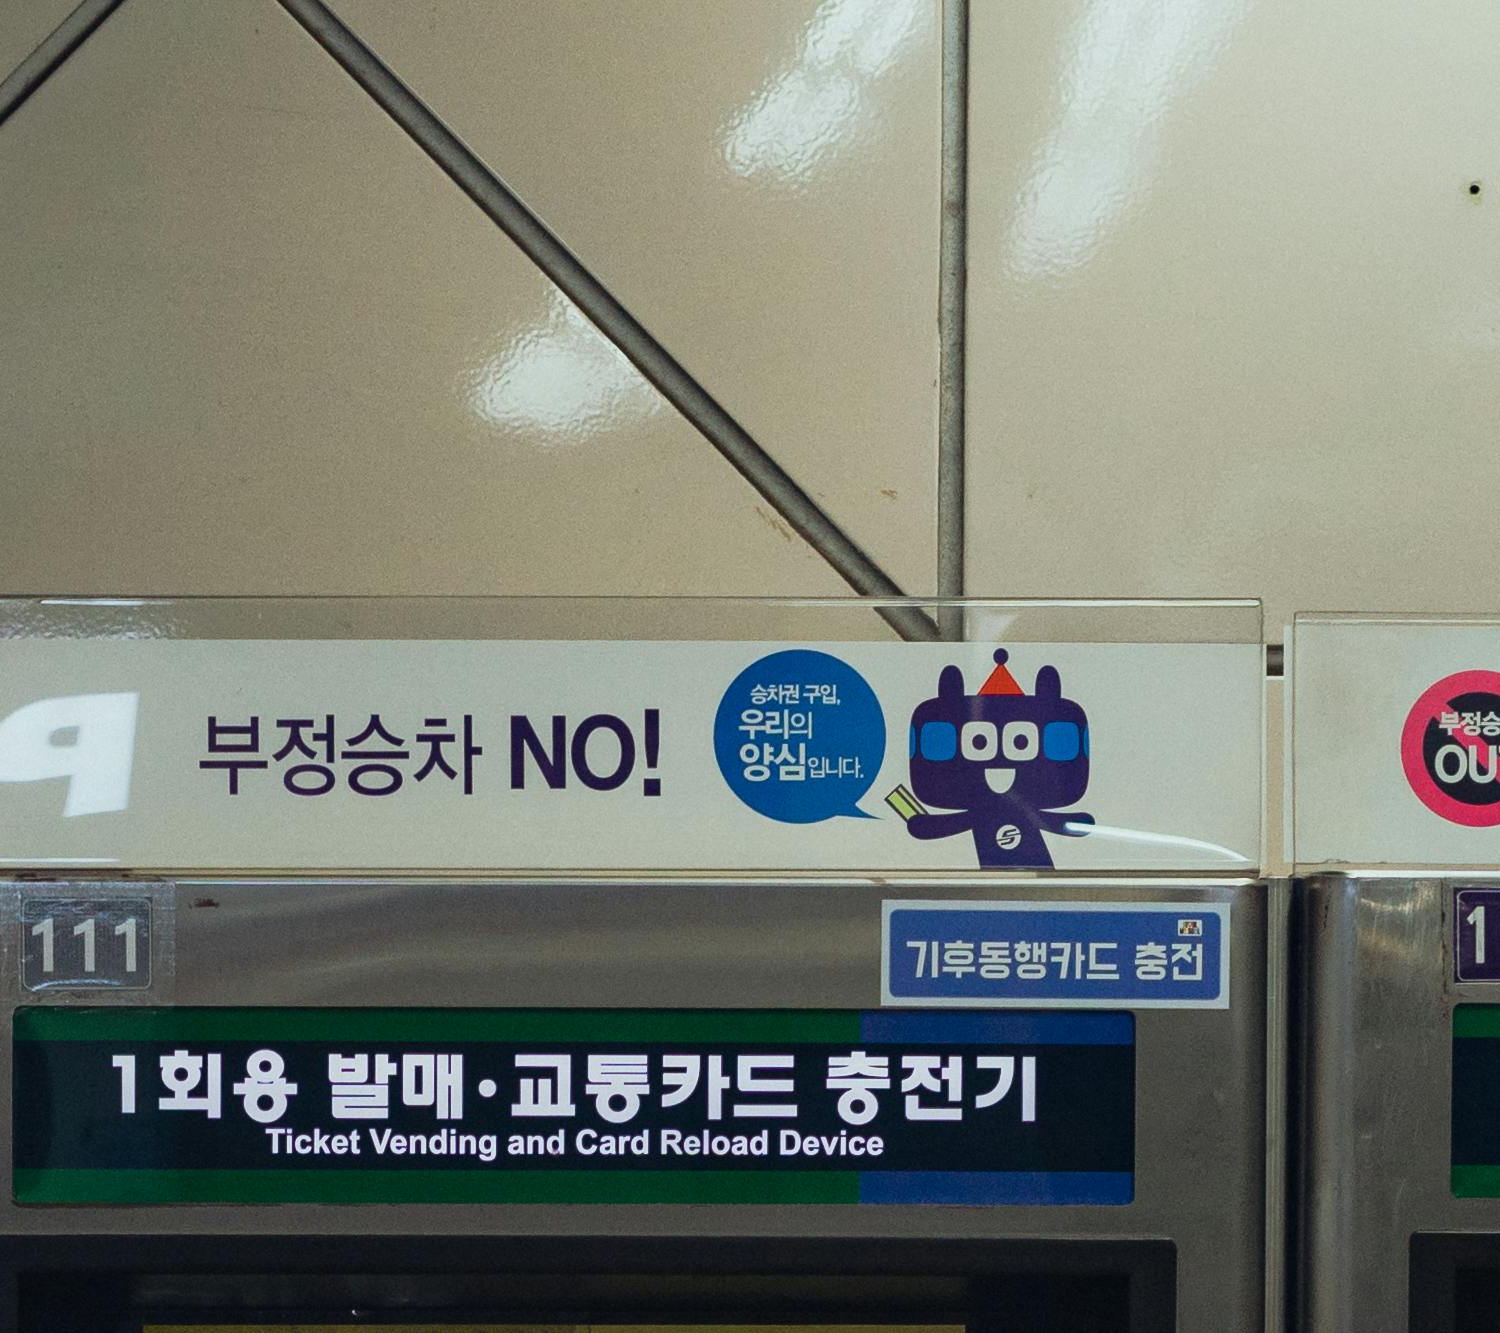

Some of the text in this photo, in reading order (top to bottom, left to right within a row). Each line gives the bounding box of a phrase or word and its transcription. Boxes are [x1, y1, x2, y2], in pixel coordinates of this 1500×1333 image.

[750, 683, 841, 706] 승차권 구입,
[738, 708, 813, 740] 우리의
[198, 707, 662, 798] 부정승차 NO!
[739, 742, 864, 782] 양심입니다.
[31, 915, 138, 973] 111
[906, 939, 1203, 981] 기후동행카드 충전
[111, 1048, 299, 1124] 1회용
[825, 1050, 1037, 1126] 충전기
[264, 1127, 885, 1162] Ticket Vending and Card Reload Device
